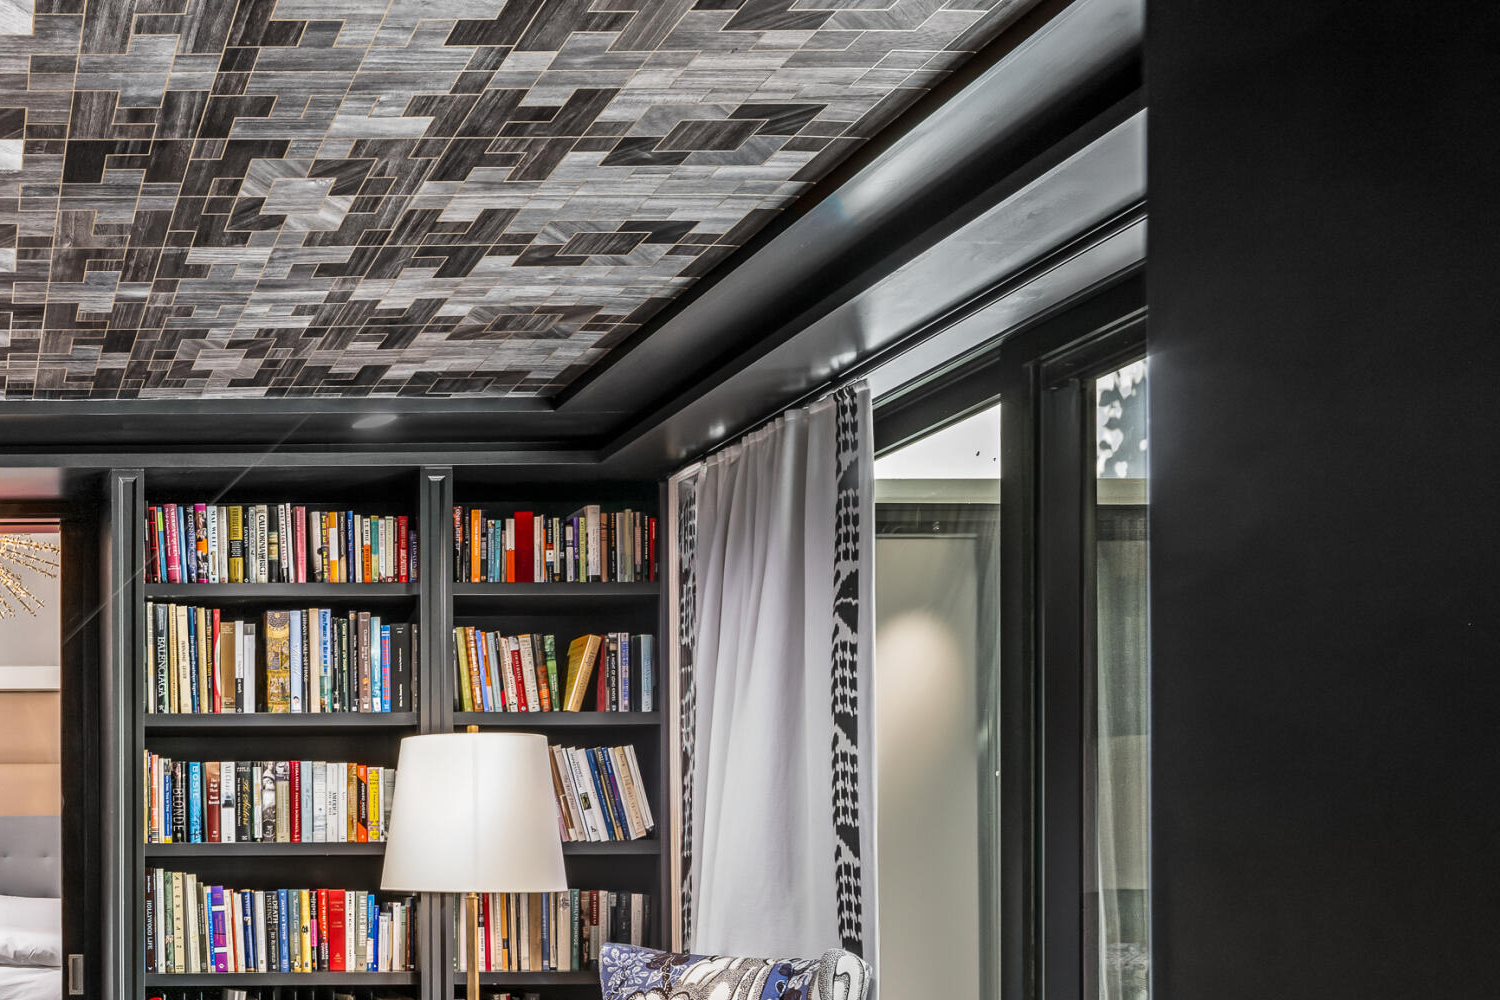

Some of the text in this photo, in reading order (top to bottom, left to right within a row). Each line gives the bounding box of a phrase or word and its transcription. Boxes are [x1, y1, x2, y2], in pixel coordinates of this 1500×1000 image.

[258, 514, 266, 576] CALIFORNIA RICH
[157, 636, 166, 697] BALENCIAGA
[172, 787, 184, 832] BLONDE
[242, 795, 252, 826] Sisters
[265, 894, 273, 924] INSTINCT
